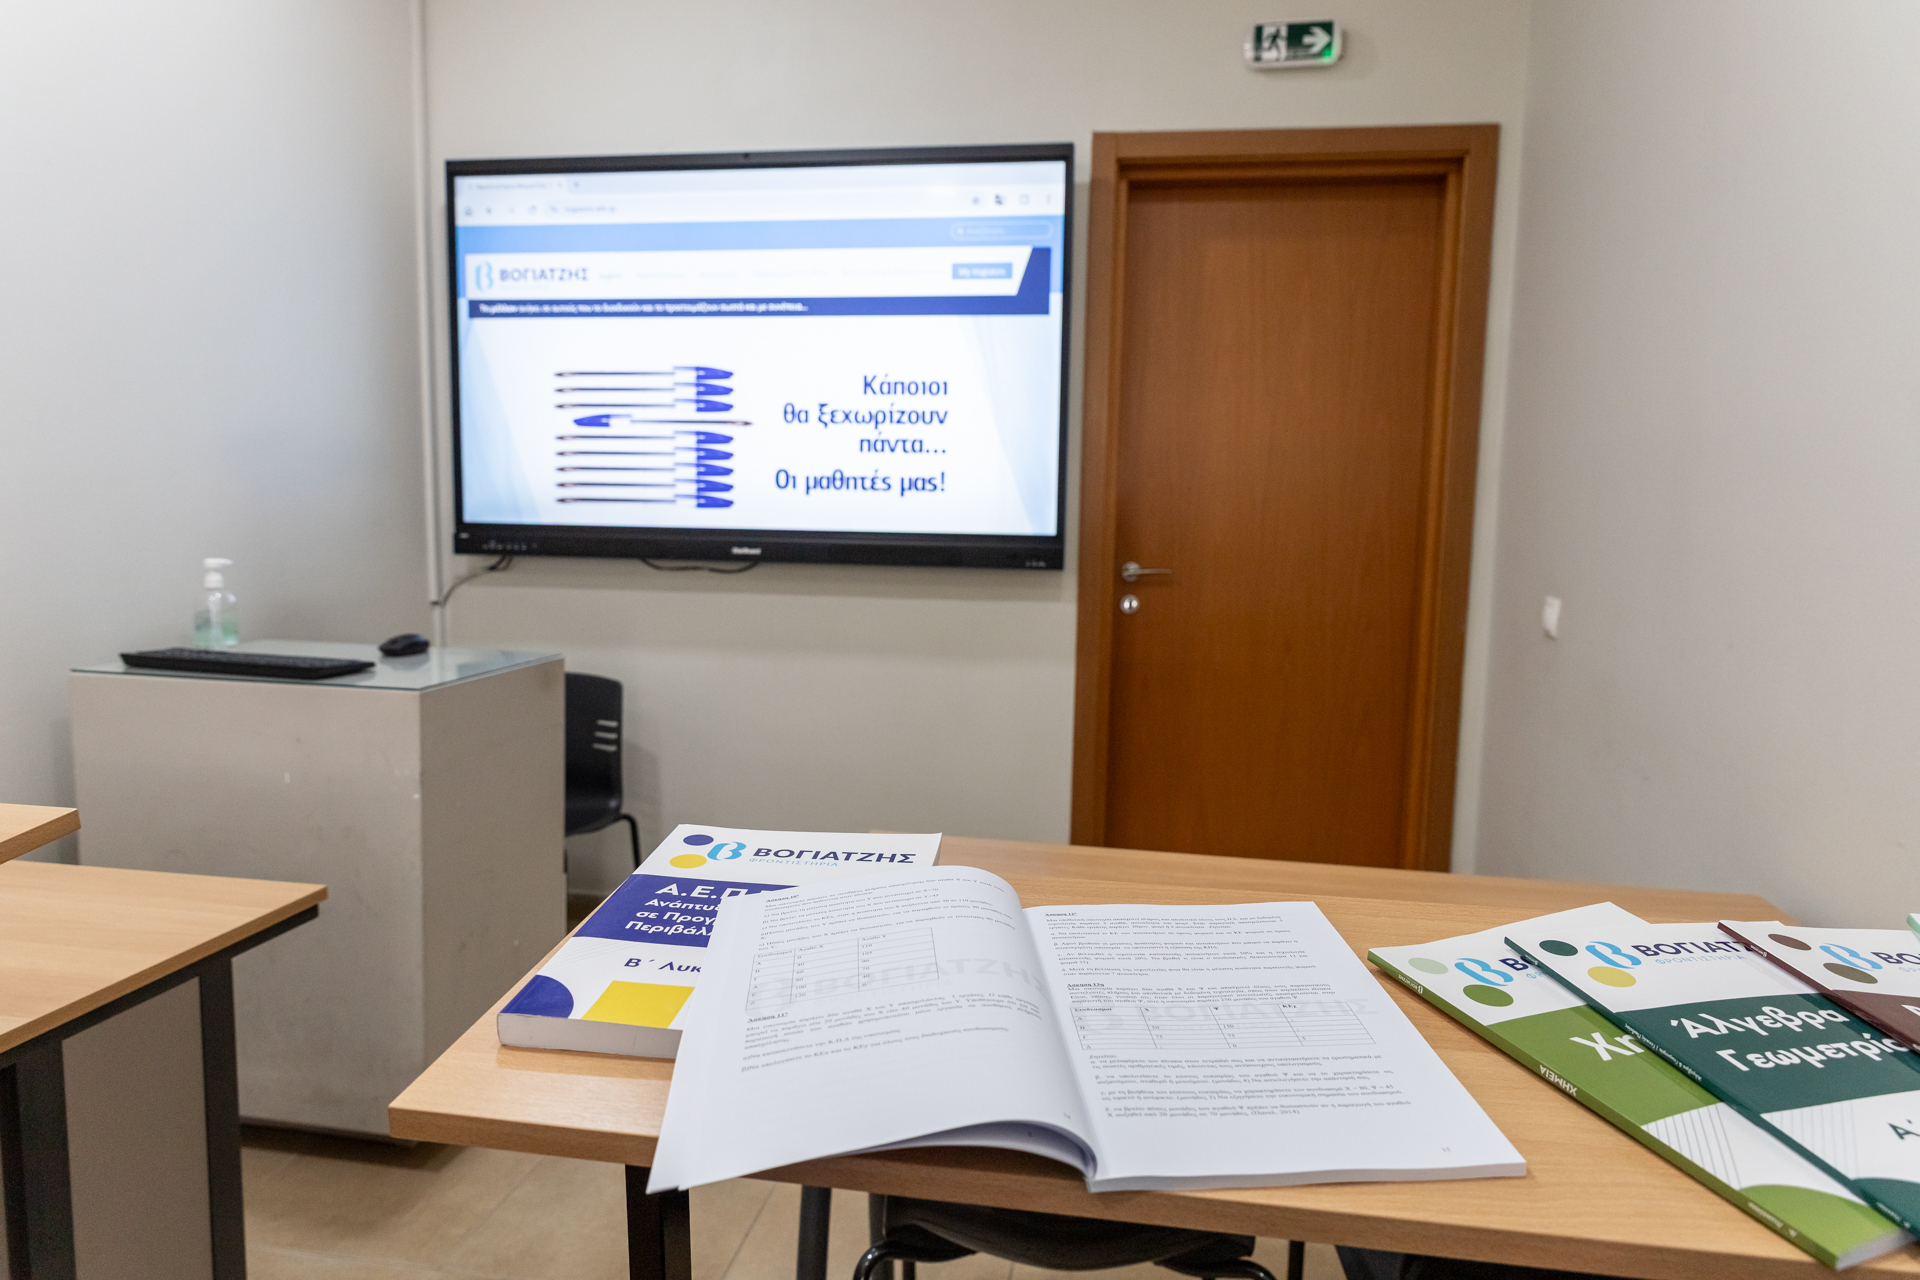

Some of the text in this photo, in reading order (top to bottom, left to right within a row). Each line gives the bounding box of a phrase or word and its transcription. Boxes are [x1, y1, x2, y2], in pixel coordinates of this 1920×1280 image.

[500, 268, 590, 282] ΒΟΓΙΑΤΖΗΣ
[863, 373, 948, 395] Κάποιοι
[783, 402, 948, 430] θα ξεχωρίζουν
[859, 431, 947, 453] πάντα...
[775, 469, 945, 497] Οι μαθητές μας!
[749, 857, 838, 867] ΦΡΟΝΤΙΣΤΗΡΙΑ
[753, 848, 916, 864] ΒΟΓΙΑΤΖΗΣ
[655, 883, 749, 899] Α.Ε.Π
[635, 911, 716, 926] σε Προγ
[1655, 954, 1747, 965] ΦΡΟΝΤΙΣΤΗΡΙΑ
[1870, 951, 1920, 965] ΒΟ
[1670, 1006, 1850, 1039] Άλγεβρα
[1540, 1065, 1578, 1097] ΧΗΜΕΙΑ
